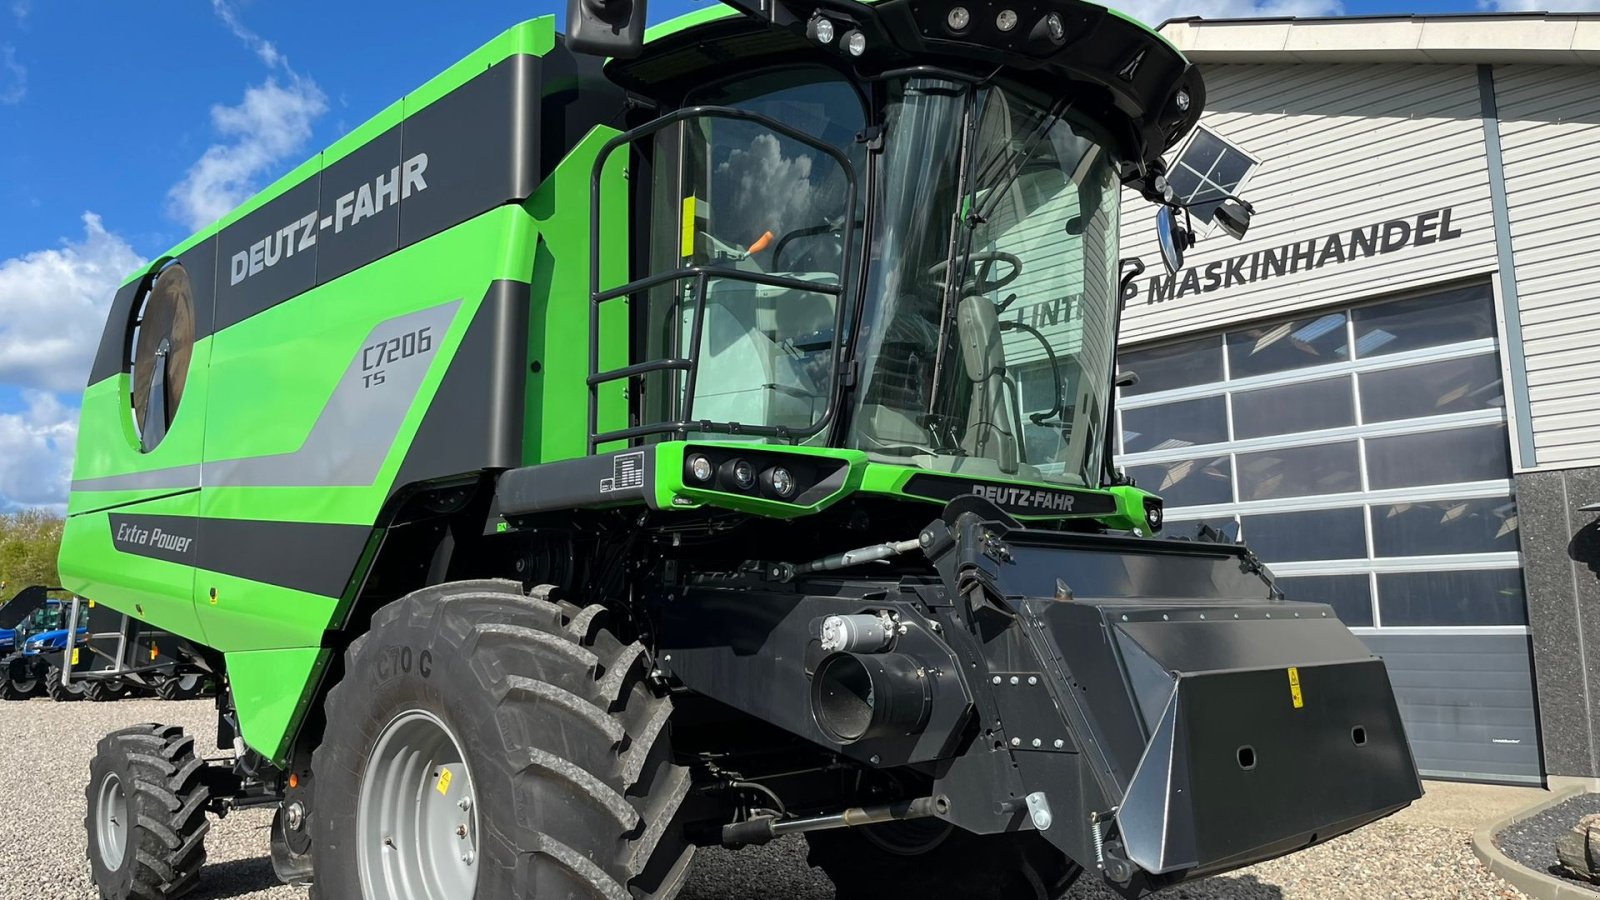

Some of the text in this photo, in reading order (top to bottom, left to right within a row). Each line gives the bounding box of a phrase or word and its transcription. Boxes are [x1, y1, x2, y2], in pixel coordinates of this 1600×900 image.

[231, 153, 429, 286] DEUTZ-FAHR
[1147, 208, 1462, 305] MASKINHANDEL
[362, 326, 432, 372] C7206
[362, 370, 386, 389] TS
[972, 484, 1075, 512] DEUTZ-FAHR
[117, 523, 192, 553] Extra Power
